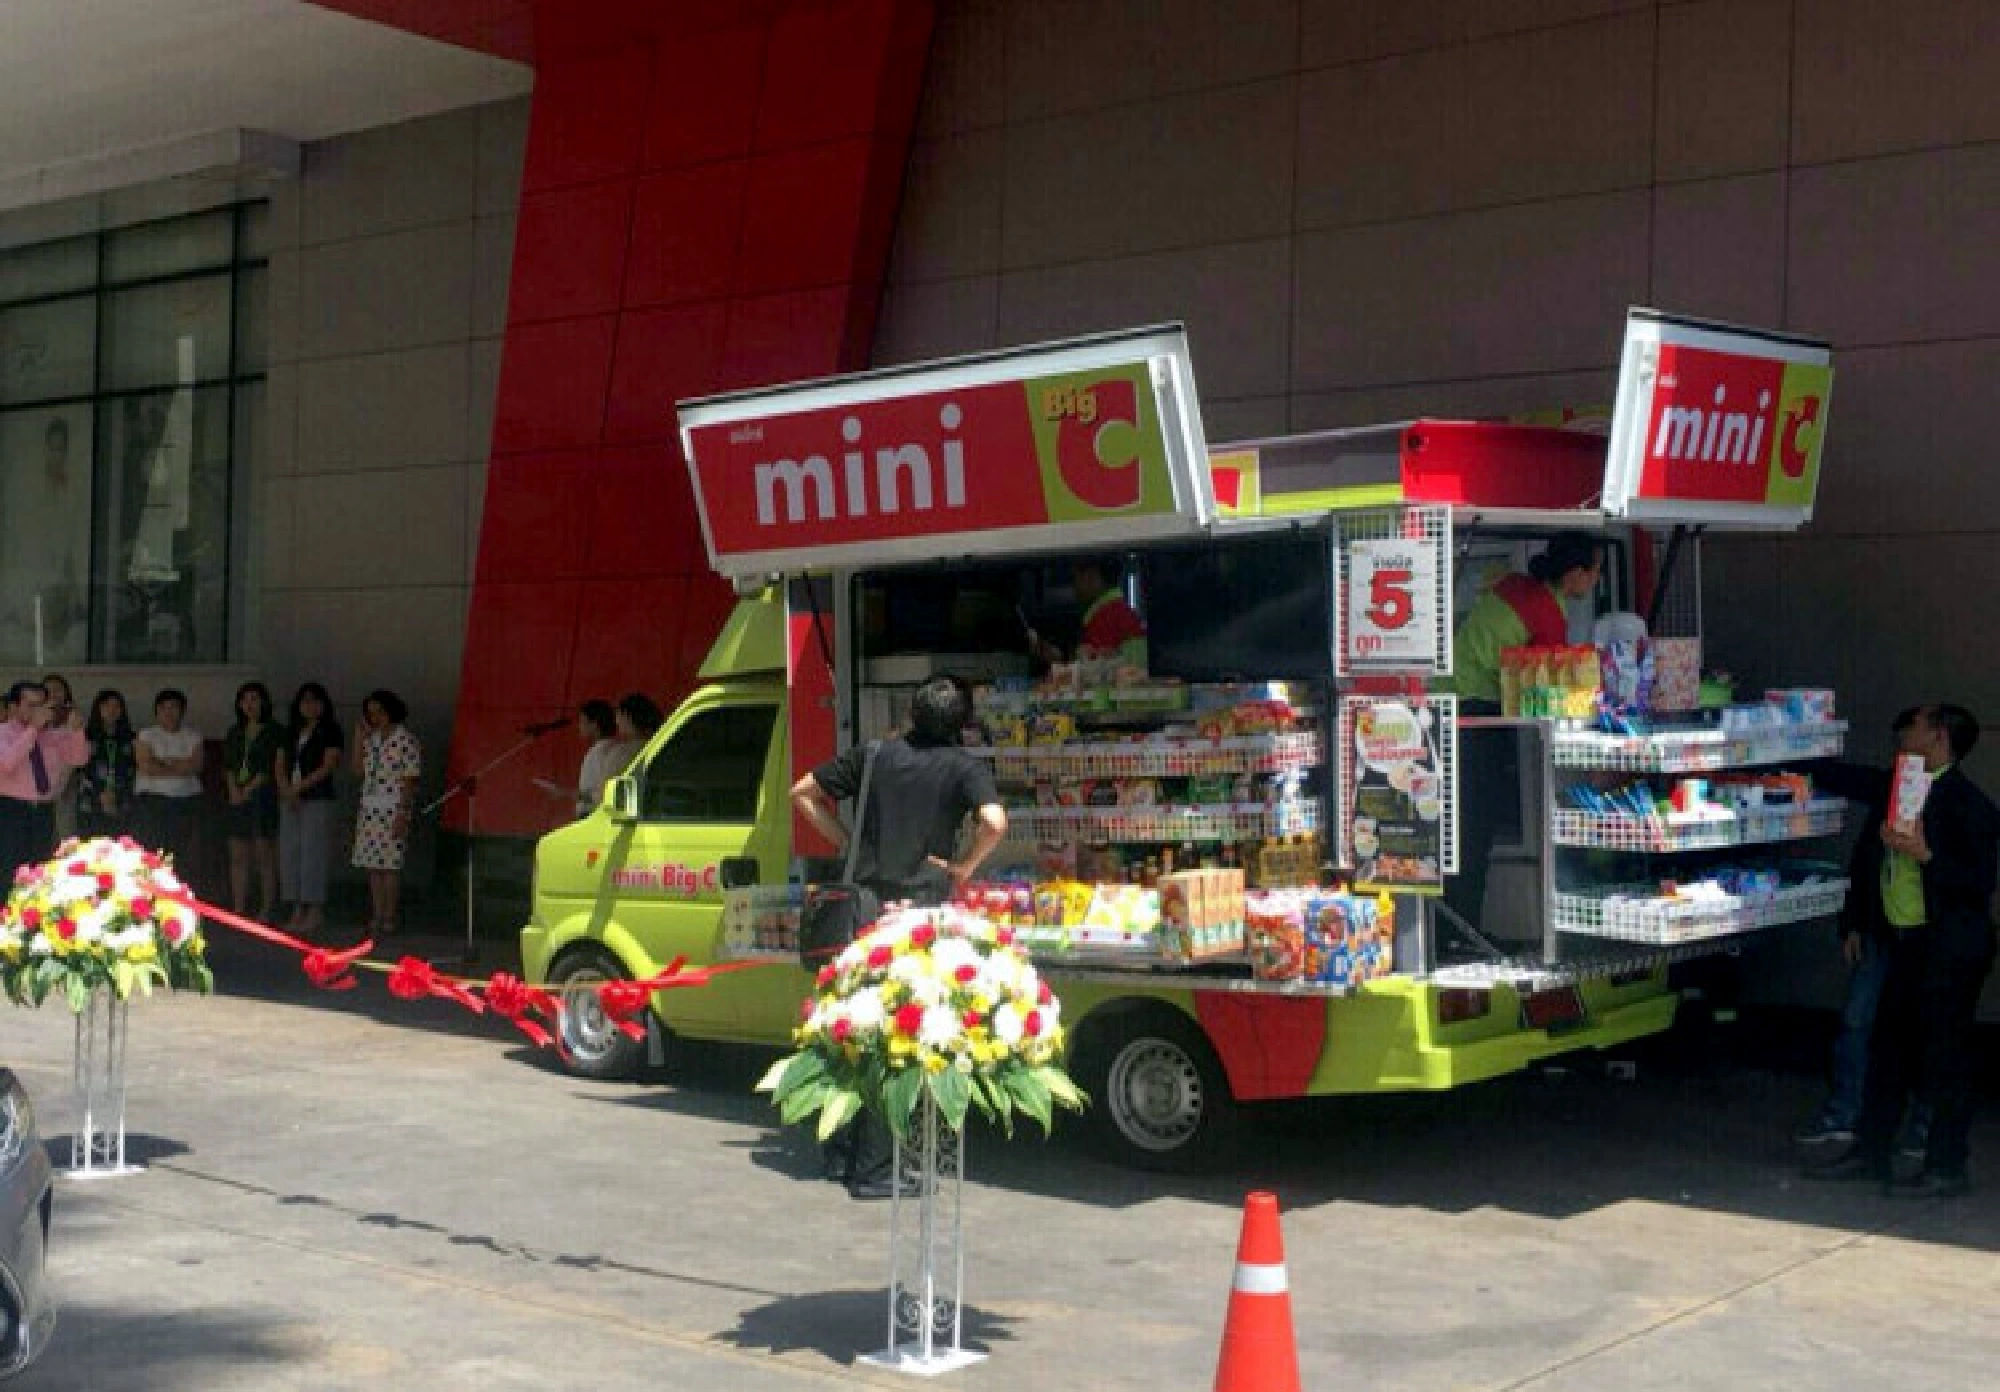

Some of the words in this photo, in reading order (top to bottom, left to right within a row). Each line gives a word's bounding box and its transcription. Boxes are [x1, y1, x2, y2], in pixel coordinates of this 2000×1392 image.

[1044, 384, 1098, 422] Big
[1653, 384, 1771, 466] mini
[754, 403, 966, 526] mini
[1056, 379, 1142, 509] C
[1366, 568, 1414, 630] 5
[612, 864, 657, 887] mini
[663, 863, 697, 894] Big
[703, 865, 717, 890] C
